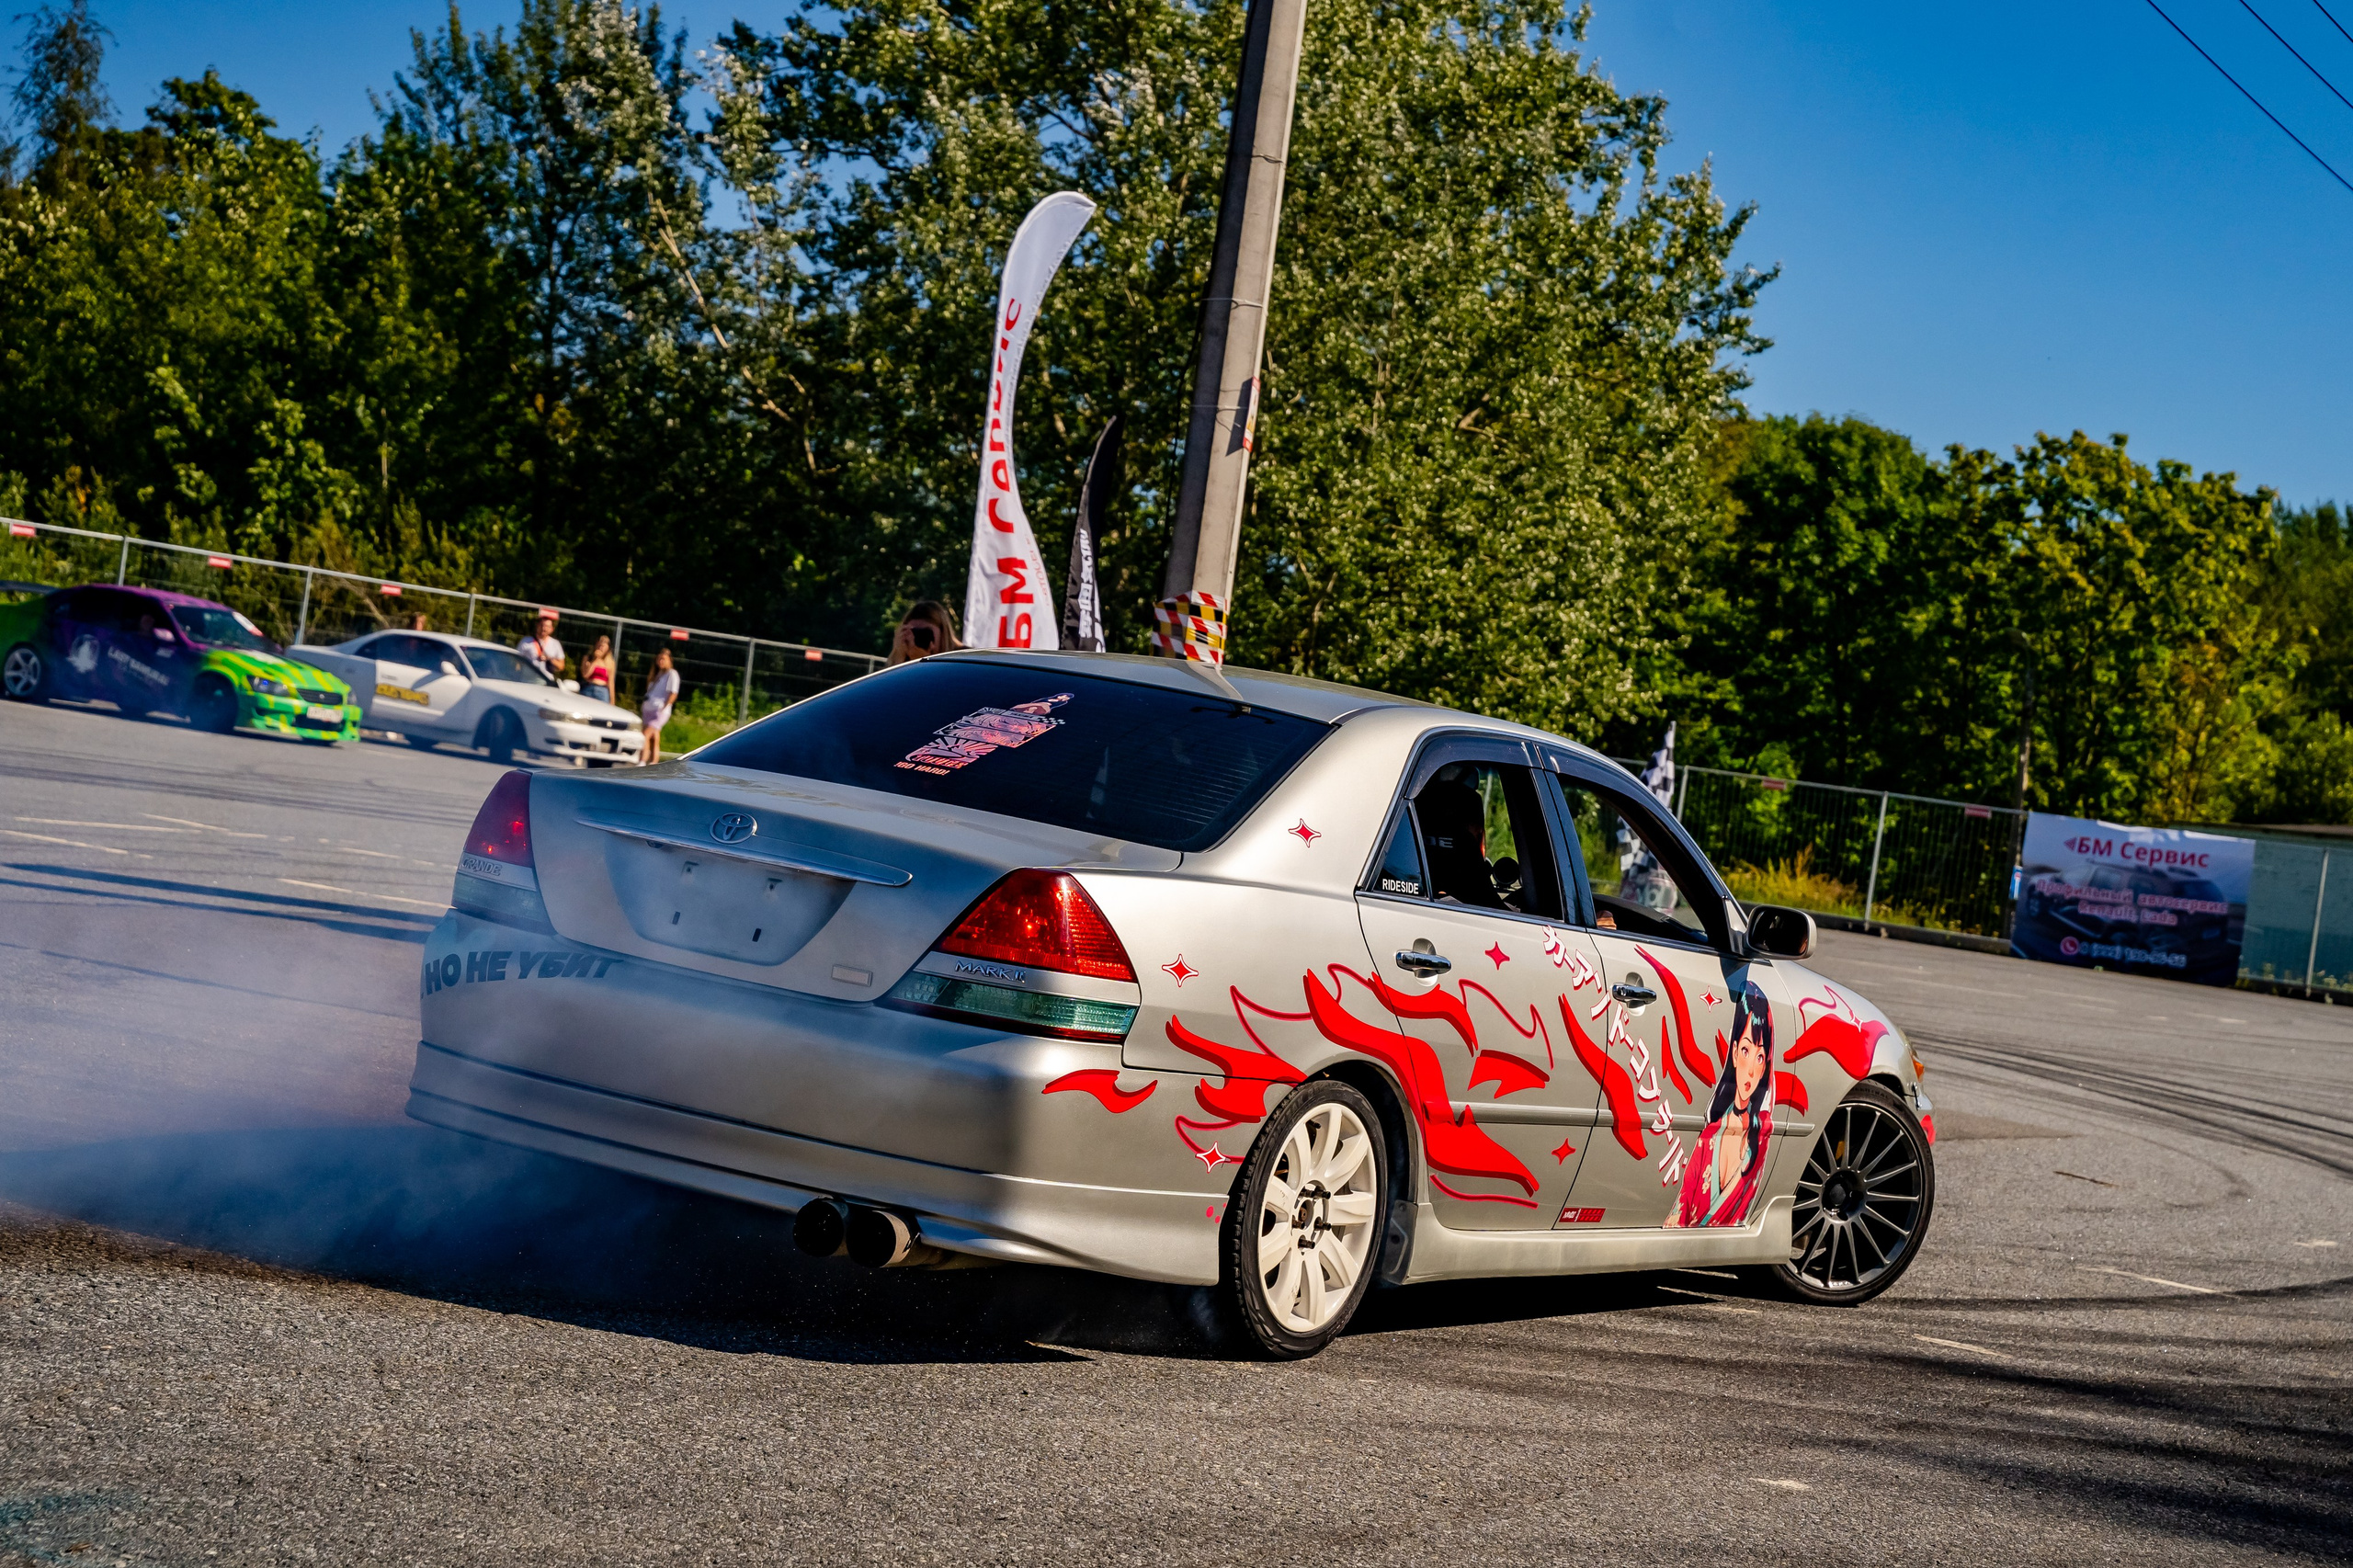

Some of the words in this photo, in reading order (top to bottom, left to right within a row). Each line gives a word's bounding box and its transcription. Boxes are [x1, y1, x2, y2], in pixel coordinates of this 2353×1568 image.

[996, 556, 1034, 649] БМ
[914, 765, 950, 776] HARD!
[2077, 835, 2112, 857] БМ
[2120, 841, 2210, 868] Сервис
[462, 857, 503, 877] GRANDE
[1382, 878, 1419, 894] RIDESIDE
[2137, 892, 2228, 915] автосервис
[2140, 908, 2178, 926] Lada
[425, 953, 461, 995] НО
[466, 951, 513, 983] НЕ
[517, 951, 624, 980] УБИТ
[954, 960, 1010, 981] MARK
